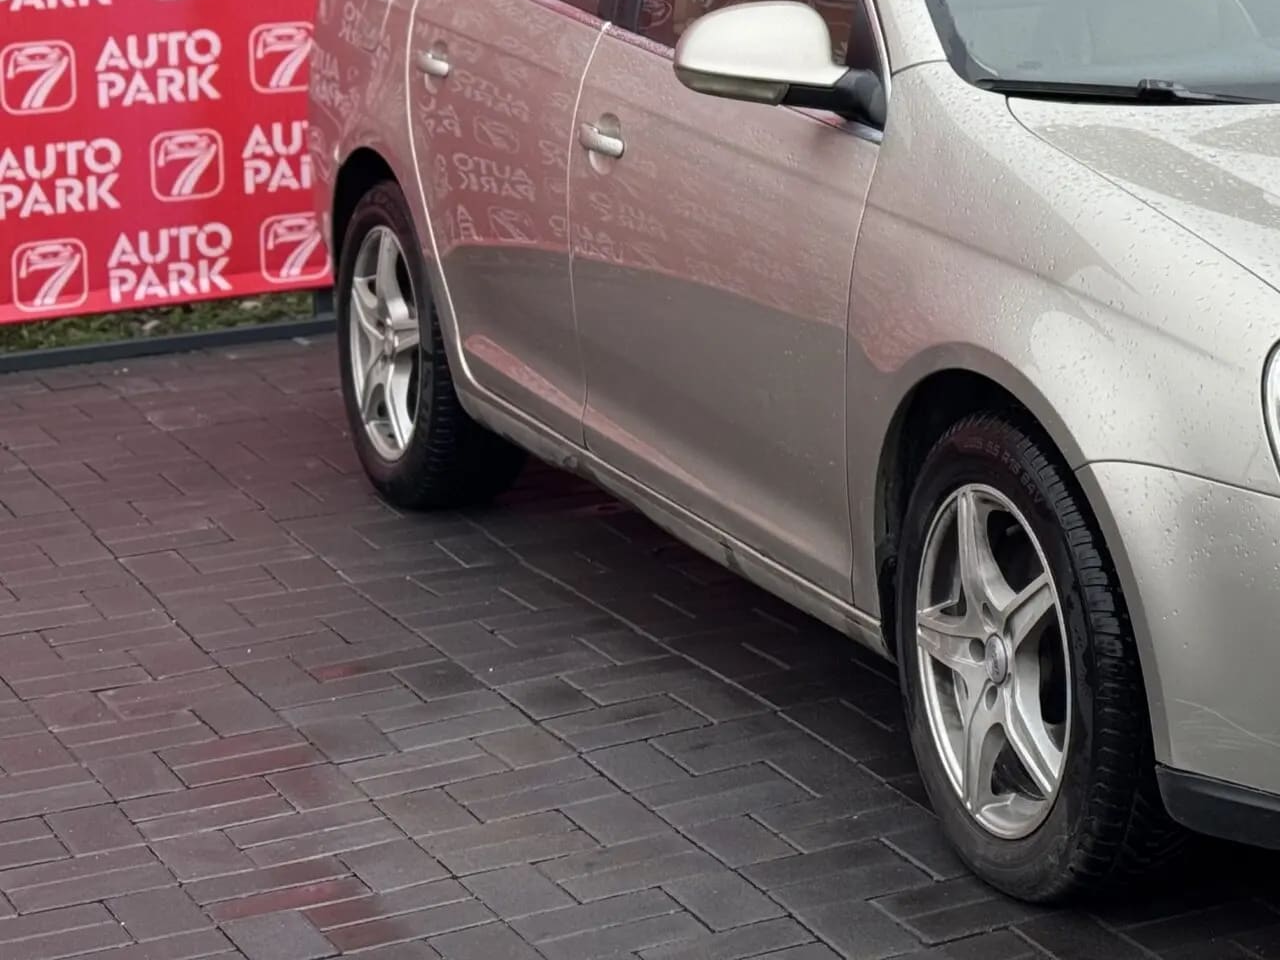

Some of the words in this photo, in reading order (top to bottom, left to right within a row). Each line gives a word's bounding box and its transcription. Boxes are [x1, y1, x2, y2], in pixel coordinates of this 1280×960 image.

[96, 29, 221, 71] AUTO
[98, 64, 221, 109] PARK
[0, 173, 120, 220] PARK
[108, 222, 232, 268] AUTO
[109, 257, 233, 304] PARK
